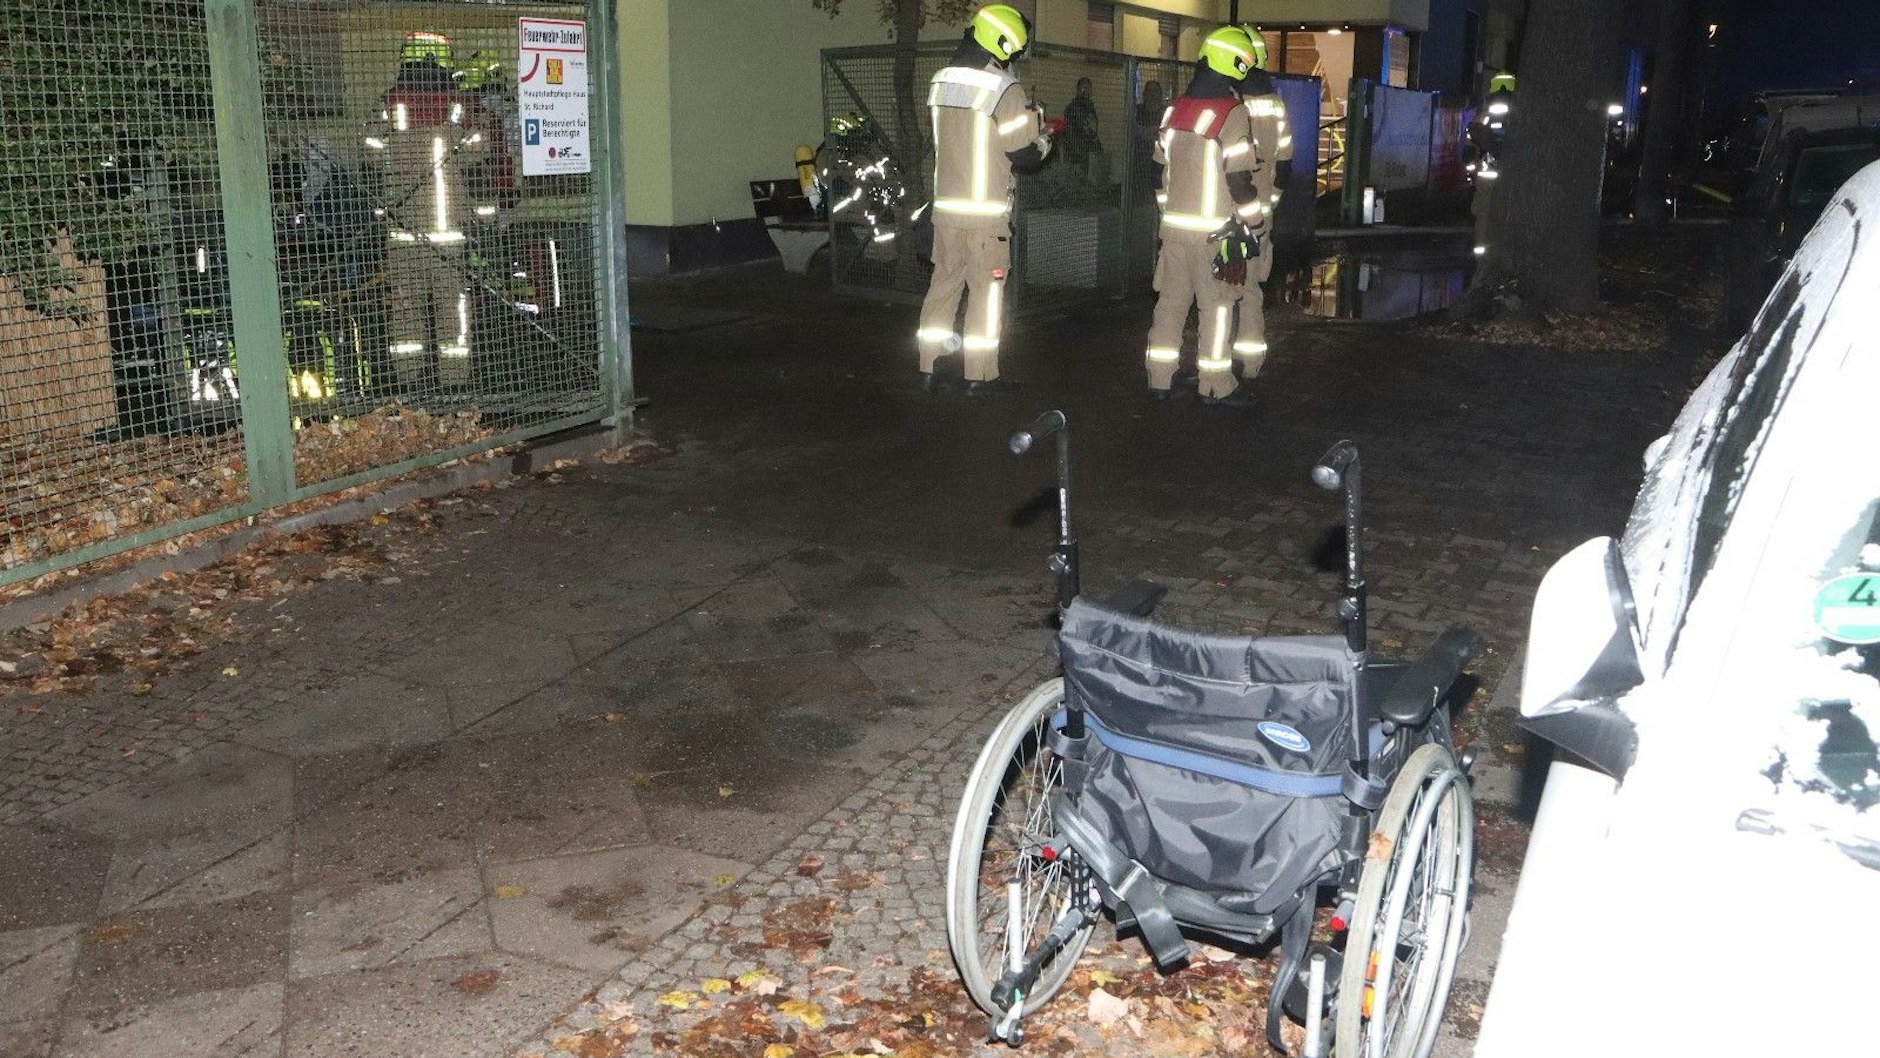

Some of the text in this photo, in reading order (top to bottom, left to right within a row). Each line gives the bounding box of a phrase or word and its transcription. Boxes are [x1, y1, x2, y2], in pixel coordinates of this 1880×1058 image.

[523, 27, 583, 45] Feuerwehr-Zufahrt
[532, 103, 554, 111] Richard
[542, 118, 586, 128] Reserviert für
[527, 123, 537, 142] P
[542, 129, 580, 139] Berechtigte
[1847, 578, 1877, 606] 4
